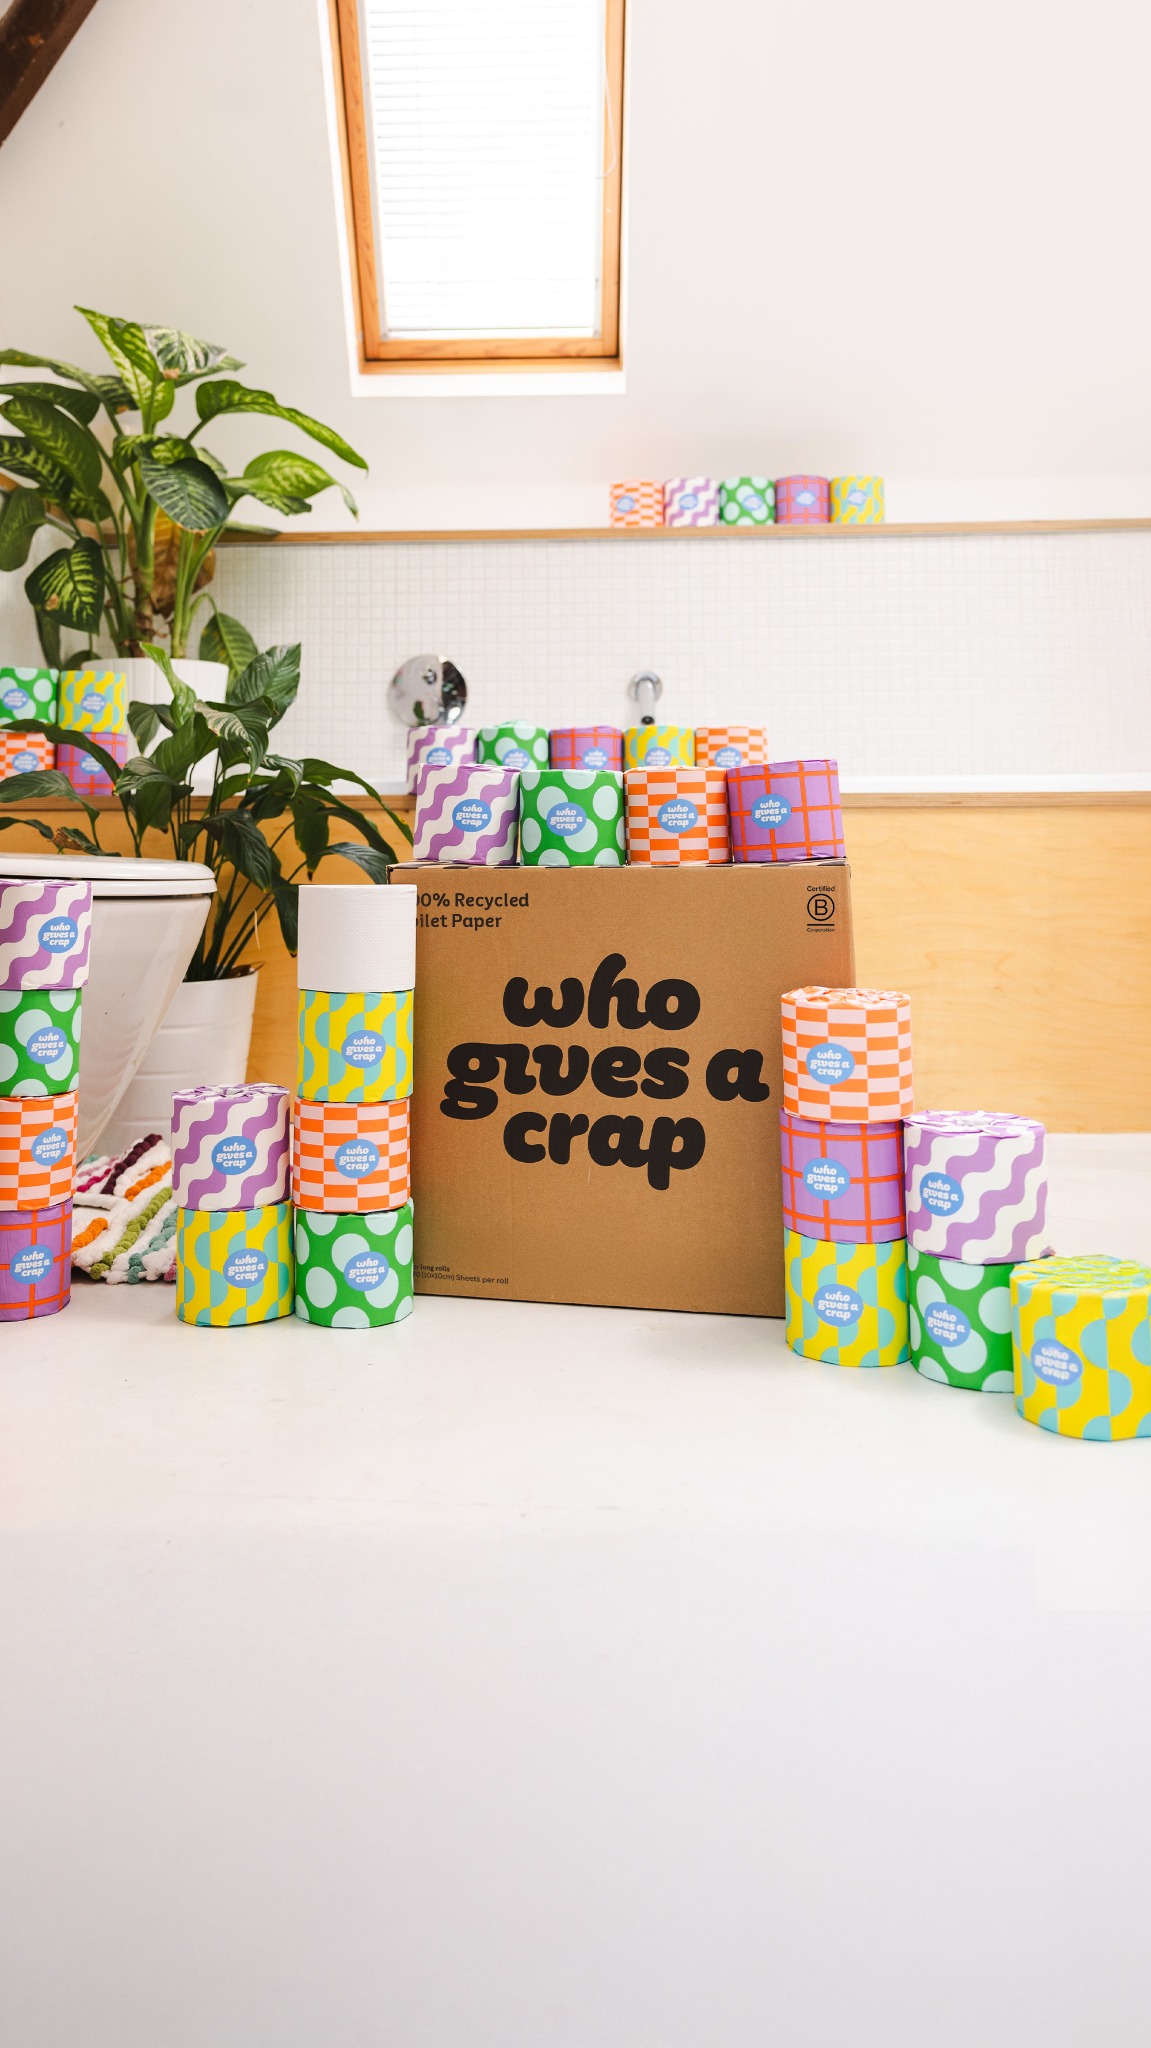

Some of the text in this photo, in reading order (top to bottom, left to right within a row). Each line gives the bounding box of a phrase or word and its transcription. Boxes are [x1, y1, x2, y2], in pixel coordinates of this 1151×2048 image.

[760, 800, 780, 808] who
[456, 812, 480, 820] gives
[662, 813, 687, 822] gives
[755, 808, 779, 818] gives
[550, 816, 575, 825] gives
[761, 815, 781, 823] crap
[455, 893, 529, 910] Recycled
[815, 899, 828, 915] B
[50, 923, 70, 931] who
[452, 914, 502, 931] Paper
[43, 932, 68, 941] gives
[503, 953, 700, 1030] who
[39, 1033, 59, 1041] who
[353, 1036, 375, 1045] who
[31, 1042, 57, 1052] gives
[346, 1046, 374, 1055] gives
[353, 1053, 375, 1062] crap
[817, 1050, 841, 1059] who
[810, 1060, 840, 1069] gives
[818, 1069, 842, 1078] crap
[440, 1042, 770, 1120] gives a
[43, 1134, 61, 1143] who
[36, 1144, 59, 1154] gives
[223, 1143, 246, 1151] who
[346, 1146, 369, 1154] who
[503, 1111, 706, 1190] crap
[216, 1152, 244, 1162] gives
[339, 1156, 367, 1165] gives
[223, 1159, 246, 1168] crap
[346, 1163, 369, 1171] crap
[813, 1165, 837, 1175] who
[807, 1174, 836, 1184] gives
[814, 1183, 838, 1194] crap
[928, 1180, 950, 1191] who
[923, 1188, 949, 1199] gives
[928, 1198, 951, 1210] crap
[22, 1251, 44, 1261] who
[235, 1255, 257, 1264] who
[14, 1261, 43, 1272] gives
[356, 1258, 378, 1267] who
[22, 1268, 44, 1277] crap
[228, 1264, 257, 1276] gives
[349, 1268, 377, 1278] gives
[235, 1272, 258, 1281] crap
[356, 1275, 378, 1284] crap
[825, 1291, 850, 1301] who
[818, 1300, 849, 1310] gives
[825, 1310, 851, 1320] crap
[933, 1310, 957, 1322] who
[927, 1316, 955, 1330] gives
[933, 1327, 957, 1341] crap
[1069, 1363, 1078, 1372] a
